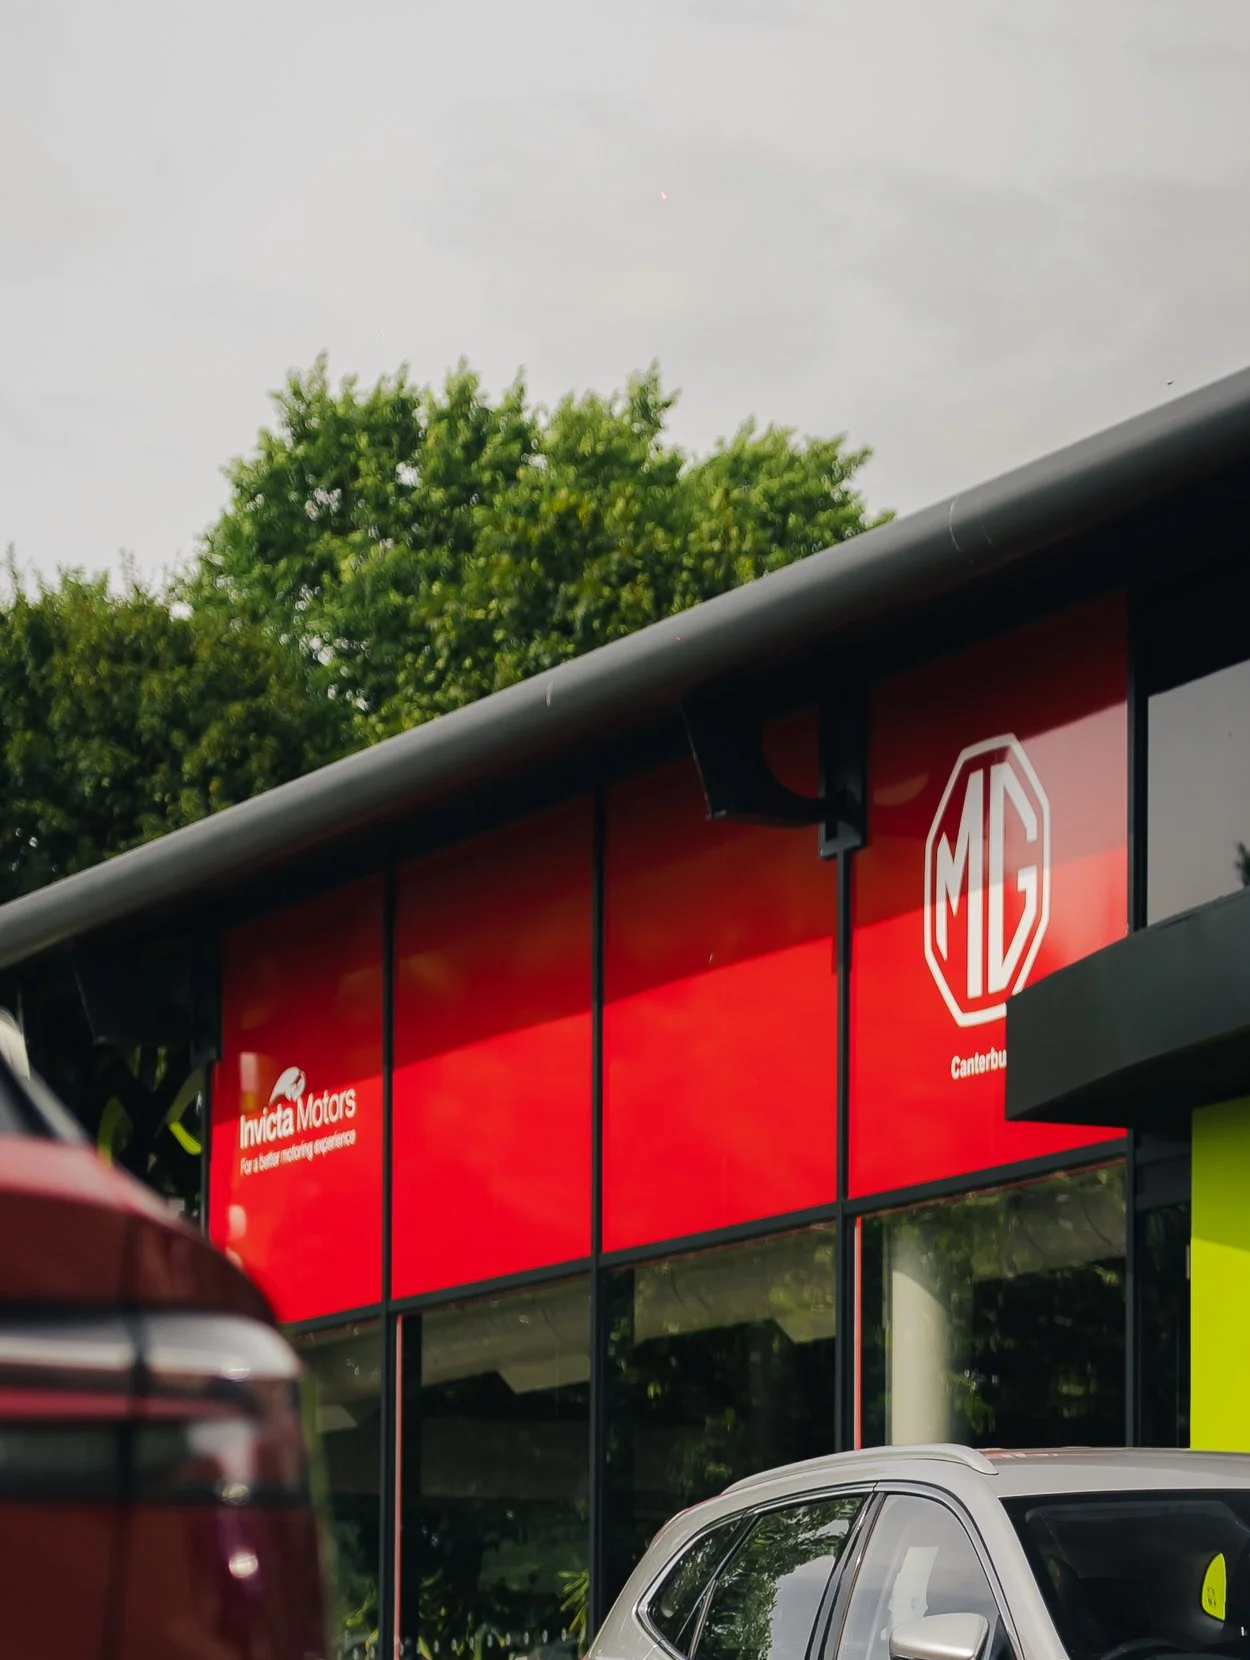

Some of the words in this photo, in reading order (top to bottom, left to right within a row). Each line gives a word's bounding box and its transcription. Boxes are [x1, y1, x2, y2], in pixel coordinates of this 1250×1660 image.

[936, 762, 1038, 1000] MG
[950, 1046, 1007, 1080] Canterbu
[240, 1104, 294, 1149] Invicta
[297, 1088, 356, 1131] Motors
[281, 1140, 313, 1163] motoring
[314, 1129, 356, 1156] experience
